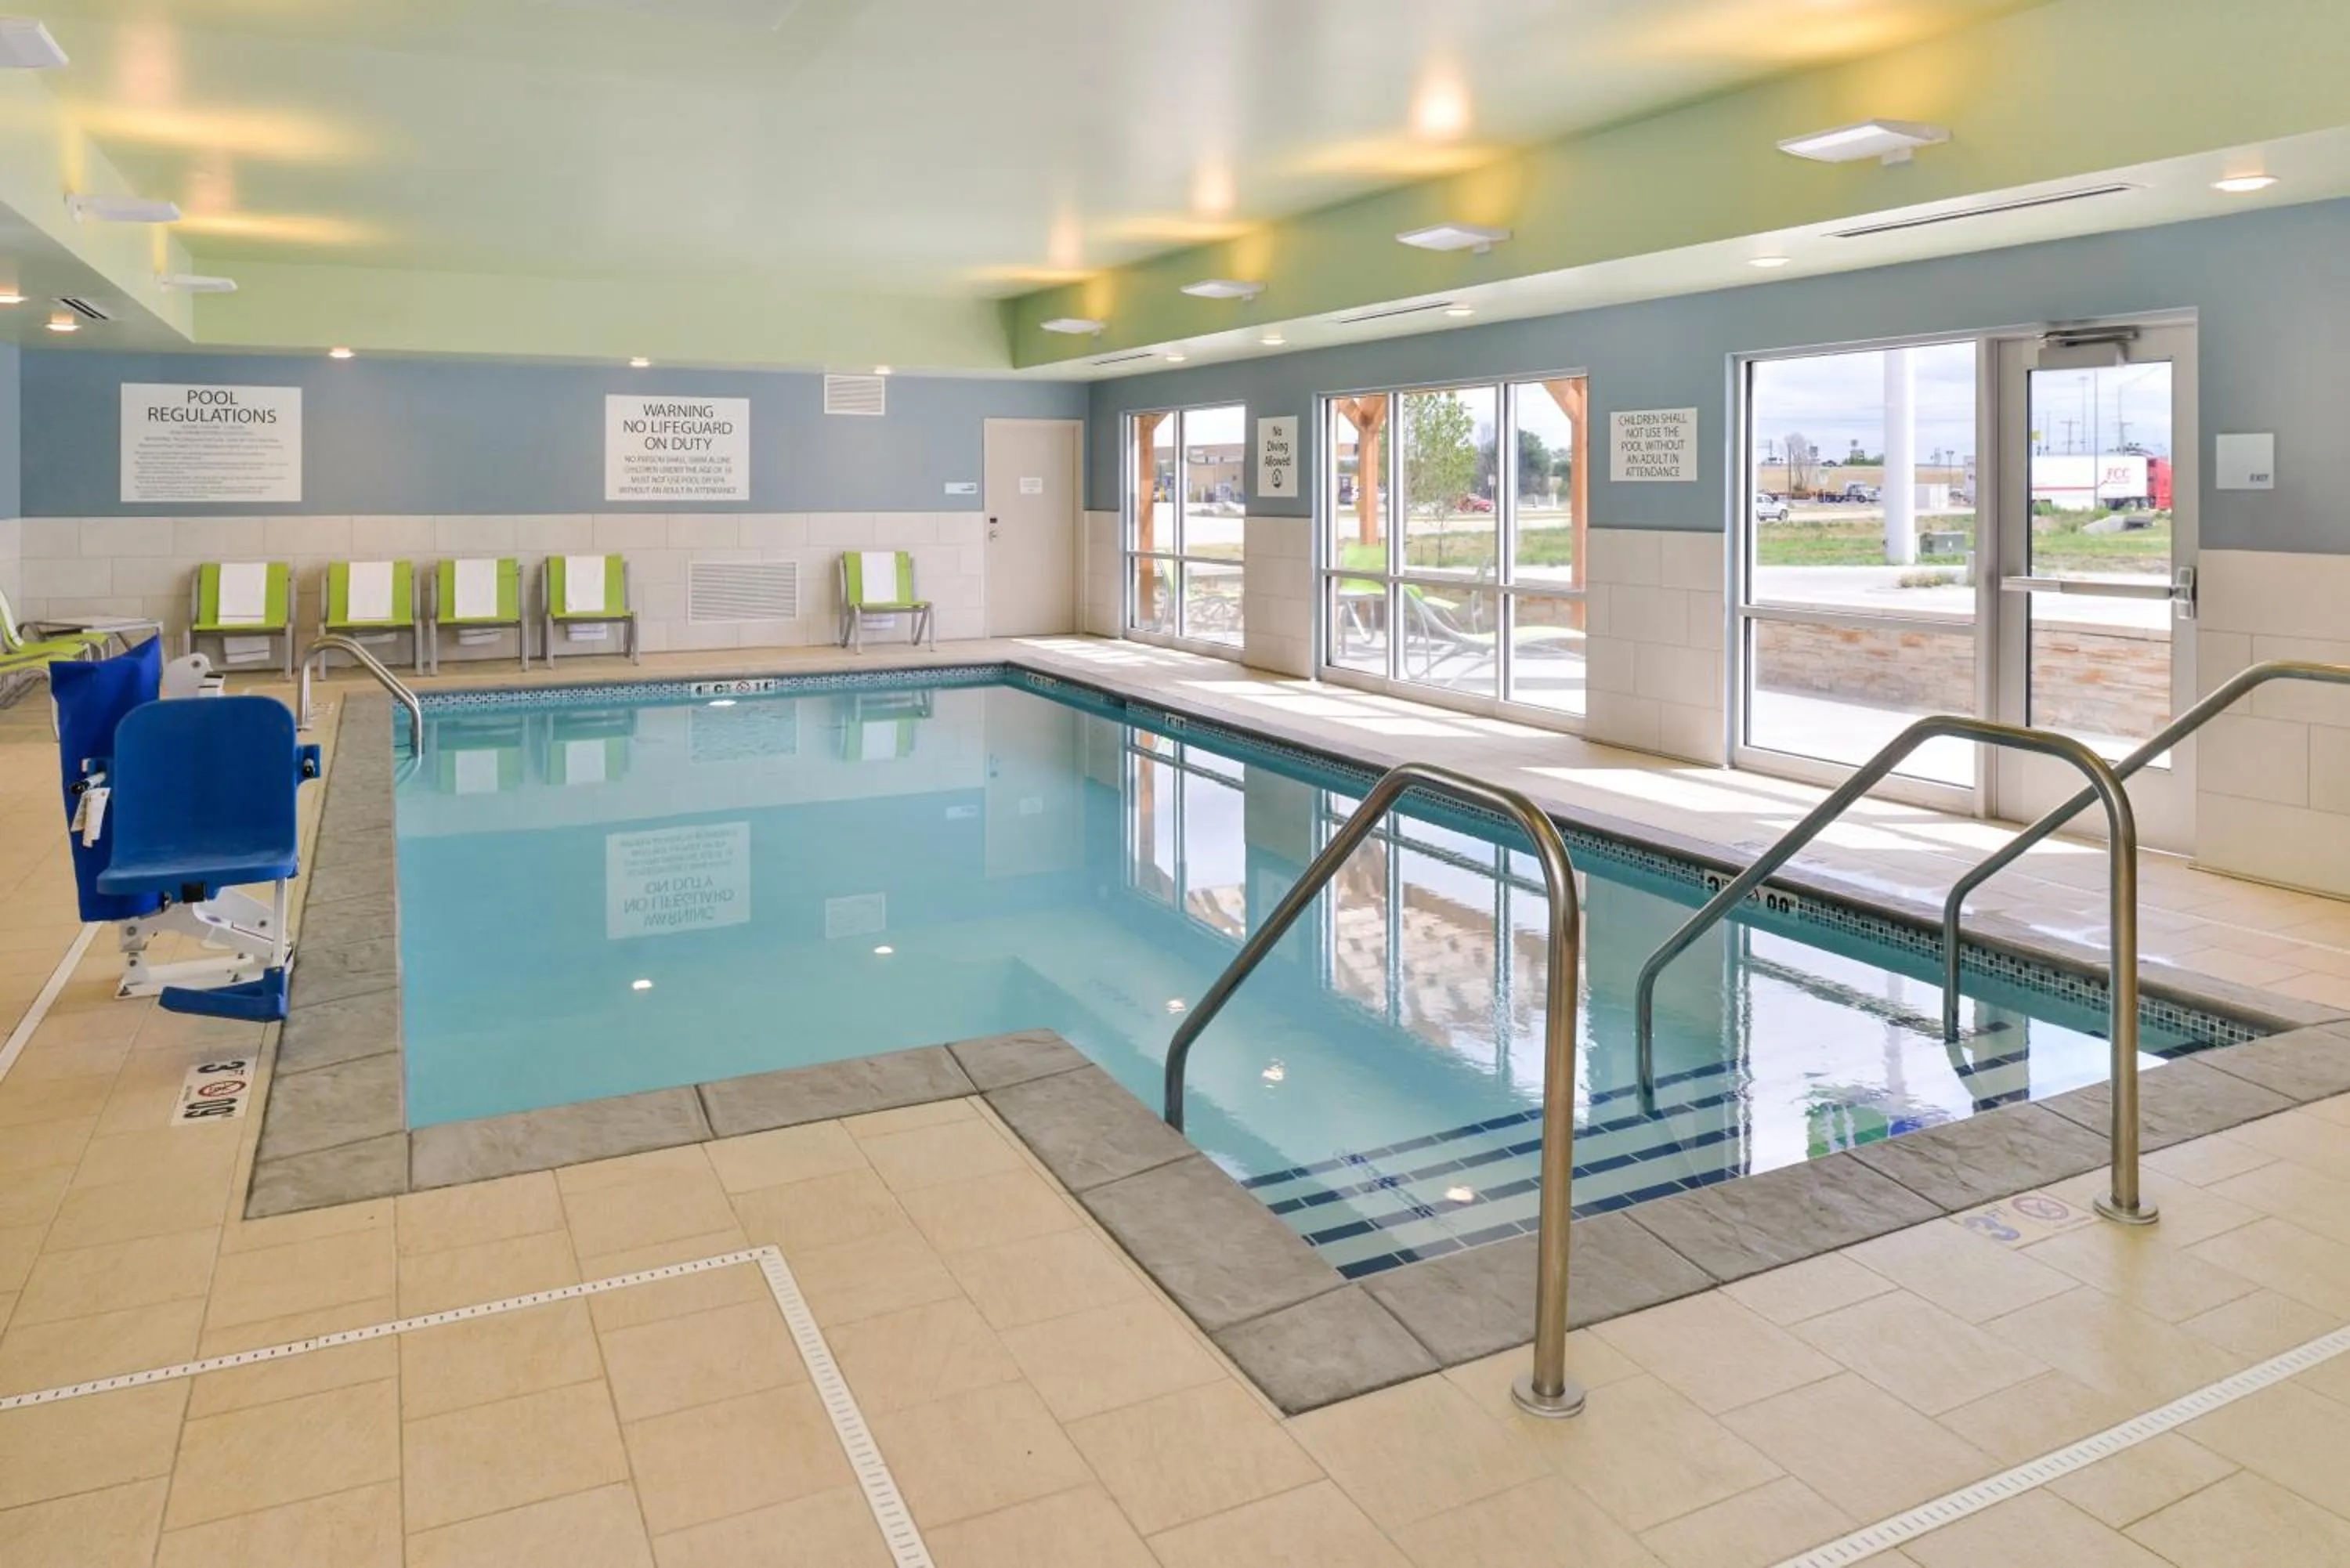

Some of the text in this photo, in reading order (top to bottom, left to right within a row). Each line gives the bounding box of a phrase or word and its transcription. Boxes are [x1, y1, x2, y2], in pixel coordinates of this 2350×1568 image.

[186, 389, 239, 405] POOL
[147, 406, 277, 424] REGULATIONS
[643, 403, 714, 418] WARNING
[1618, 413, 1687, 426] CHILDREN SHALL
[623, 420, 734, 435] NO LIFEGUARD
[1272, 426, 1282, 436] No
[1625, 426, 1679, 438] NOT USE THE
[644, 437, 713, 450] ON DUTY
[1267, 440, 1289, 455] Diving
[1621, 439, 1685, 452] POOL WITHOUT
[1626, 453, 1679, 464] AN ADULT IN
[1625, 466, 1680, 477] ATTENDANCE
[2106, 467, 2131, 480] FCC
[2249, 473, 2269, 482] EXIT
[197, 1060, 246, 1074] 3
[1964, 1216, 2020, 1241] 3
